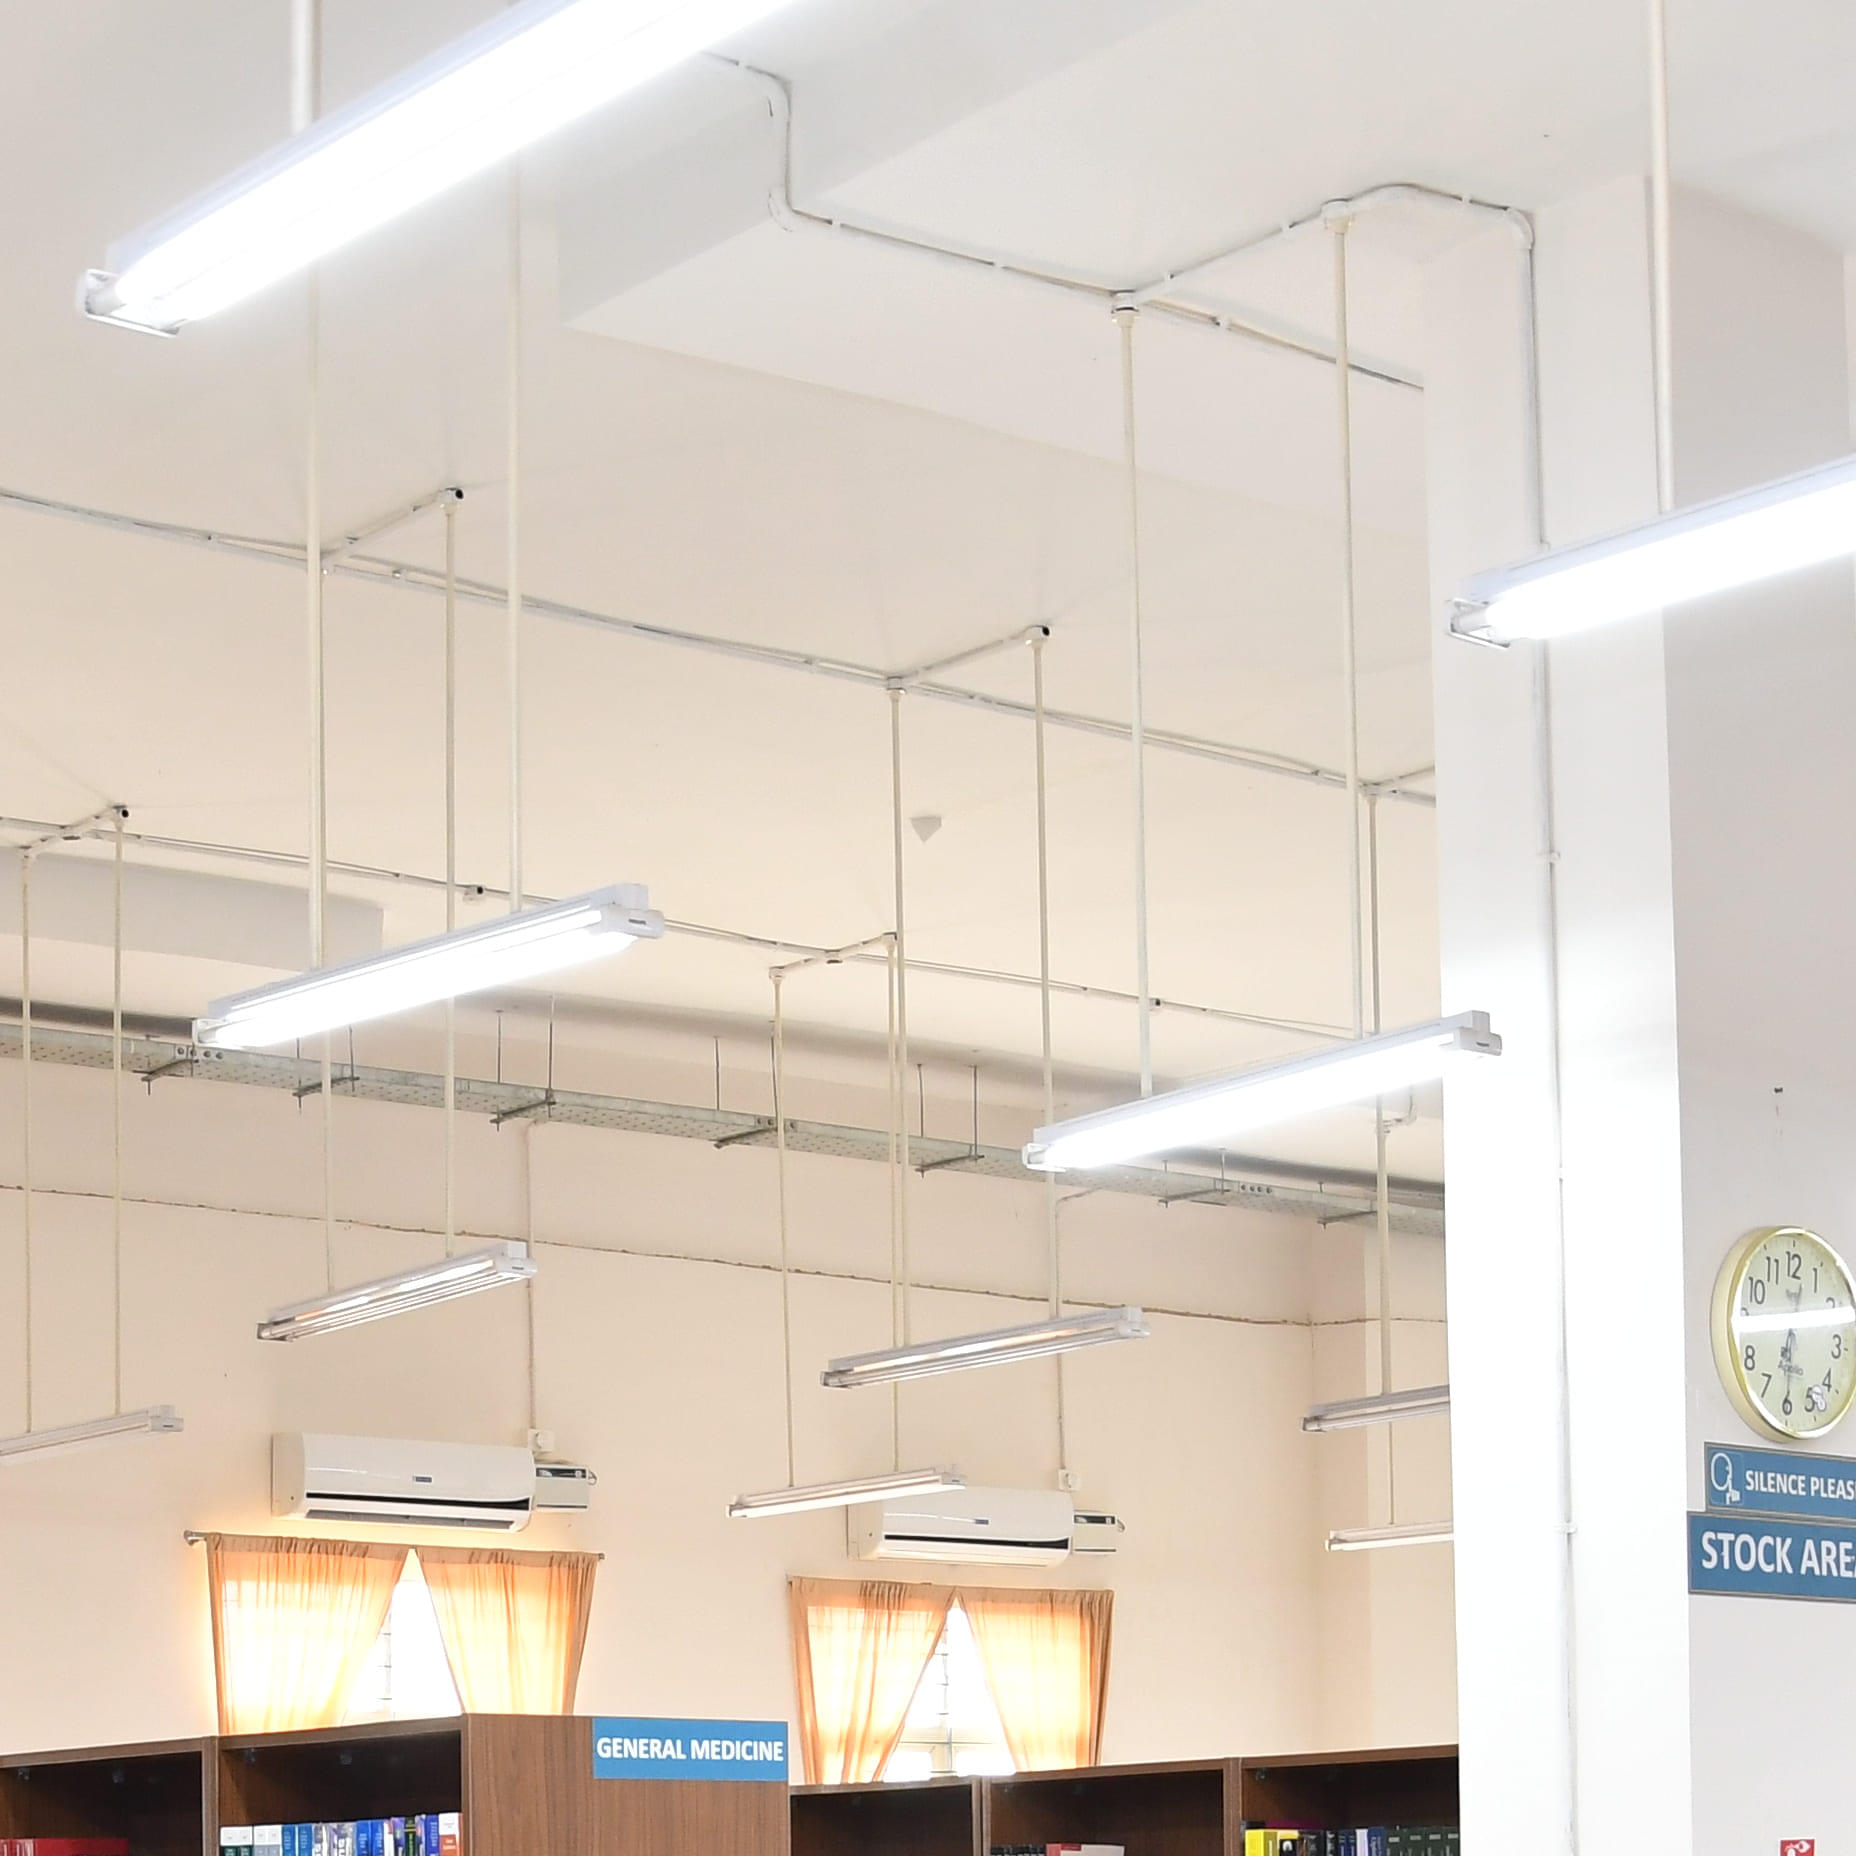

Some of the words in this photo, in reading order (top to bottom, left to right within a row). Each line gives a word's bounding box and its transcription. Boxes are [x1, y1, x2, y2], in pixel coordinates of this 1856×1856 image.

[1766, 1256, 1780, 1285] 11
[1786, 1251, 1802, 1280] 12
[1748, 1277, 1766, 1304] 10
[1813, 1267, 1819, 1293] 1
[1744, 1345, 1755, 1371] 8
[1831, 1334, 1842, 1359] 3
[1761, 1372, 1772, 1398] 7
[1823, 1368, 1832, 1392] 4
[1782, 1390, 1792, 1415] 6
[1805, 1387, 1817, 1412] 5
[1745, 1470, 1806, 1496] SILENCE
[1701, 1531, 1793, 1574] STOCK
[596, 1737, 687, 1760] GENERAL
[690, 1739, 784, 1762] MEDICINE
